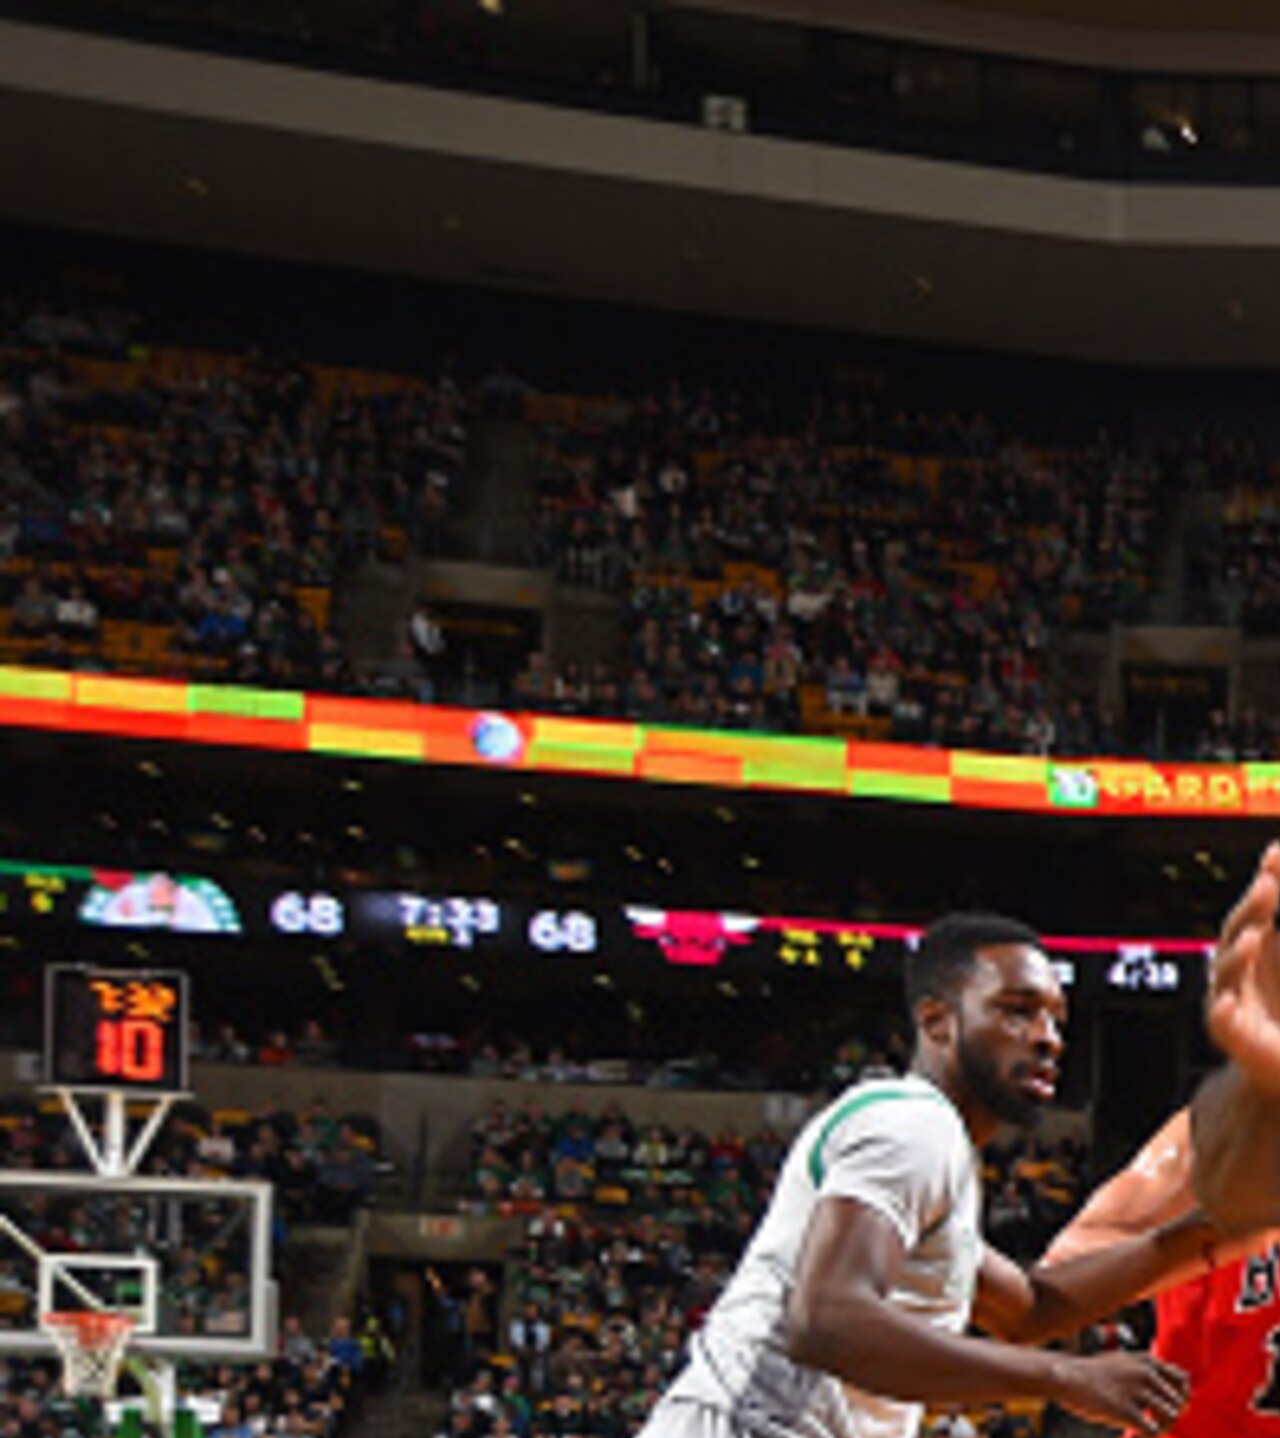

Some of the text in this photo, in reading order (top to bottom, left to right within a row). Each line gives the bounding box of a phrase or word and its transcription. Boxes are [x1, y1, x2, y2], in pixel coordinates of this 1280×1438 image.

[272, 892, 343, 934] 68
[528, 910, 597, 952] 68
[96, 1019, 164, 1082] 10
